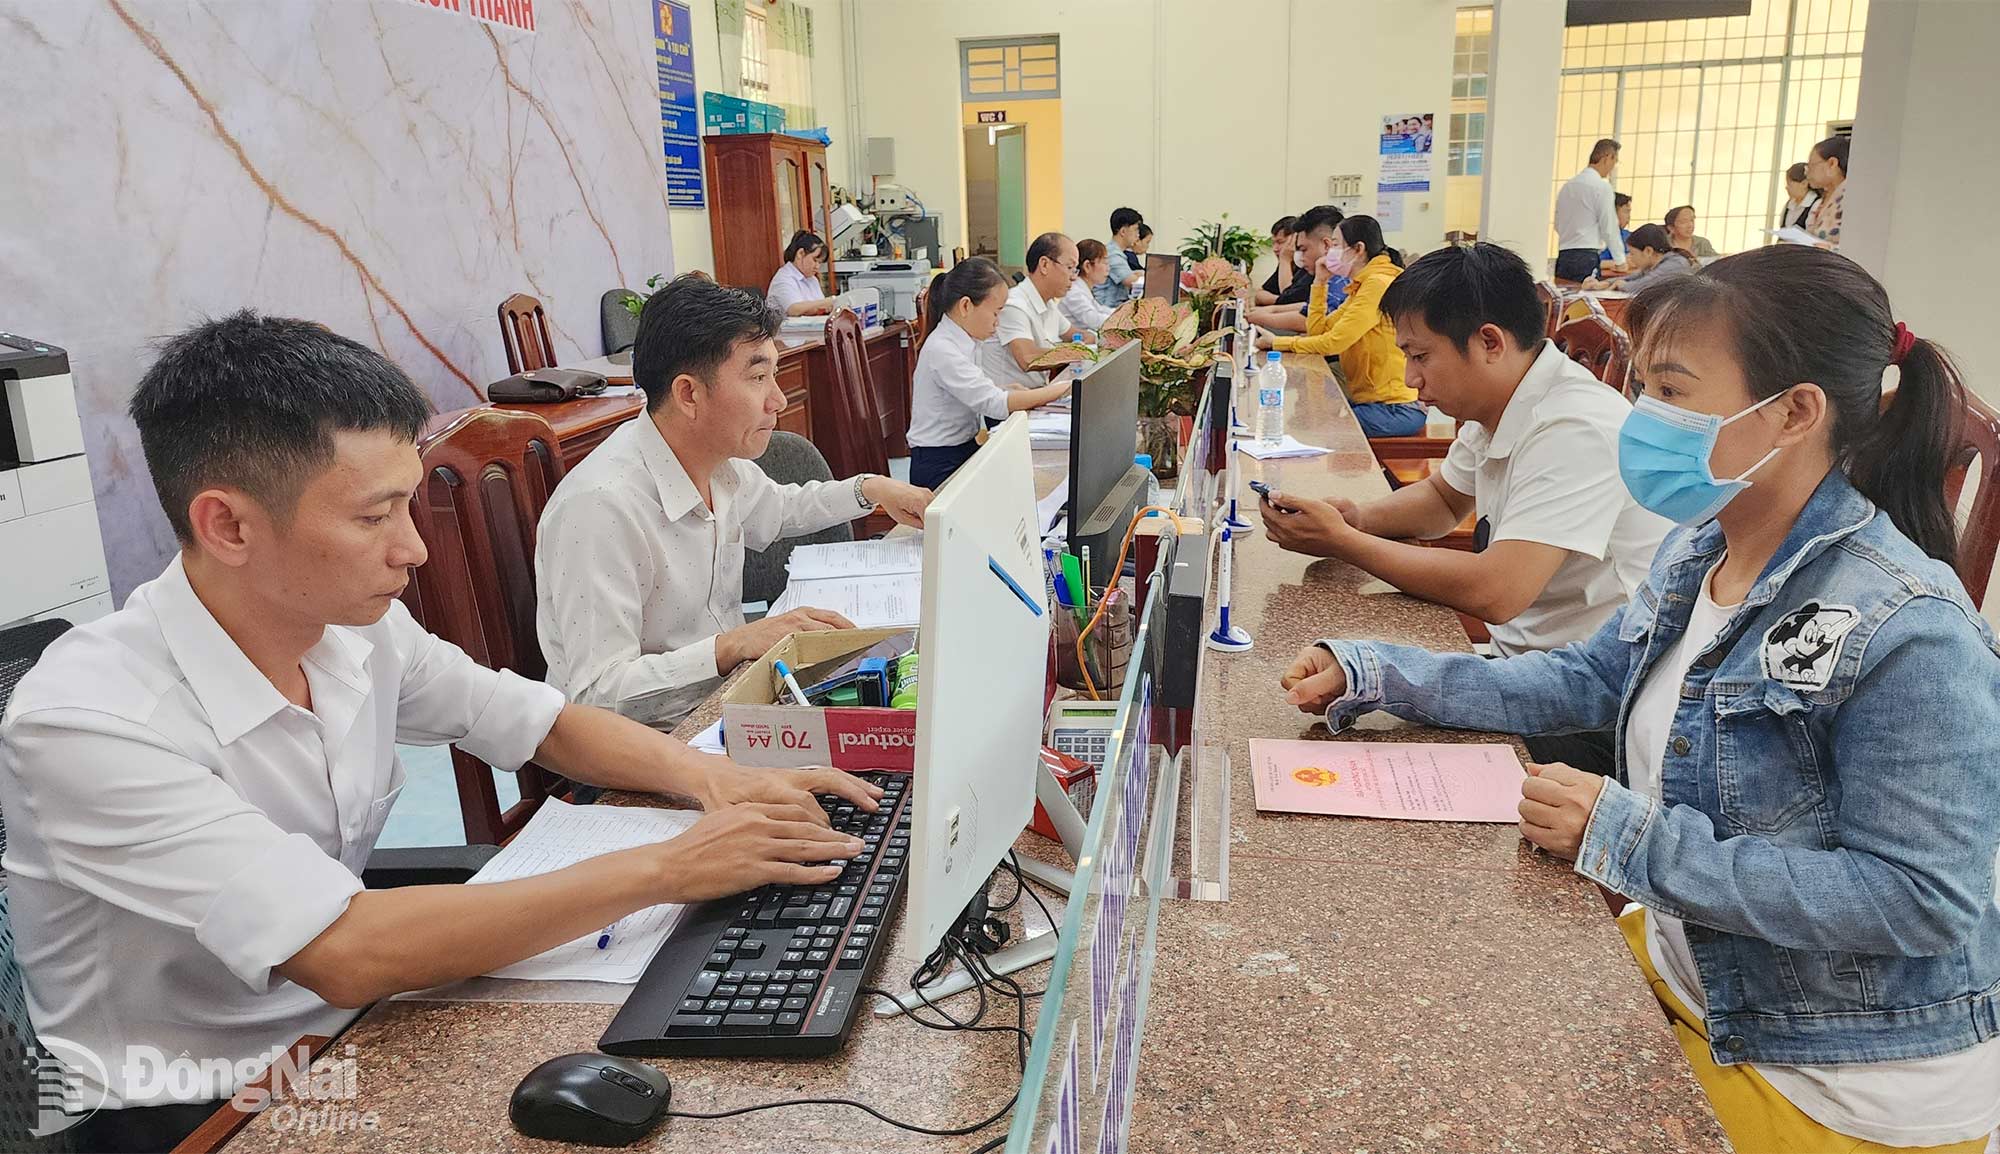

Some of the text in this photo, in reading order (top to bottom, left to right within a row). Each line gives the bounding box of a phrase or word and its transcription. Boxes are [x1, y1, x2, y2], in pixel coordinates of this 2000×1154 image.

[980, 113, 996, 122] WC
[747, 735, 772, 748] A4
[781, 730, 811, 749] 70
[839, 732, 916, 753] natural
